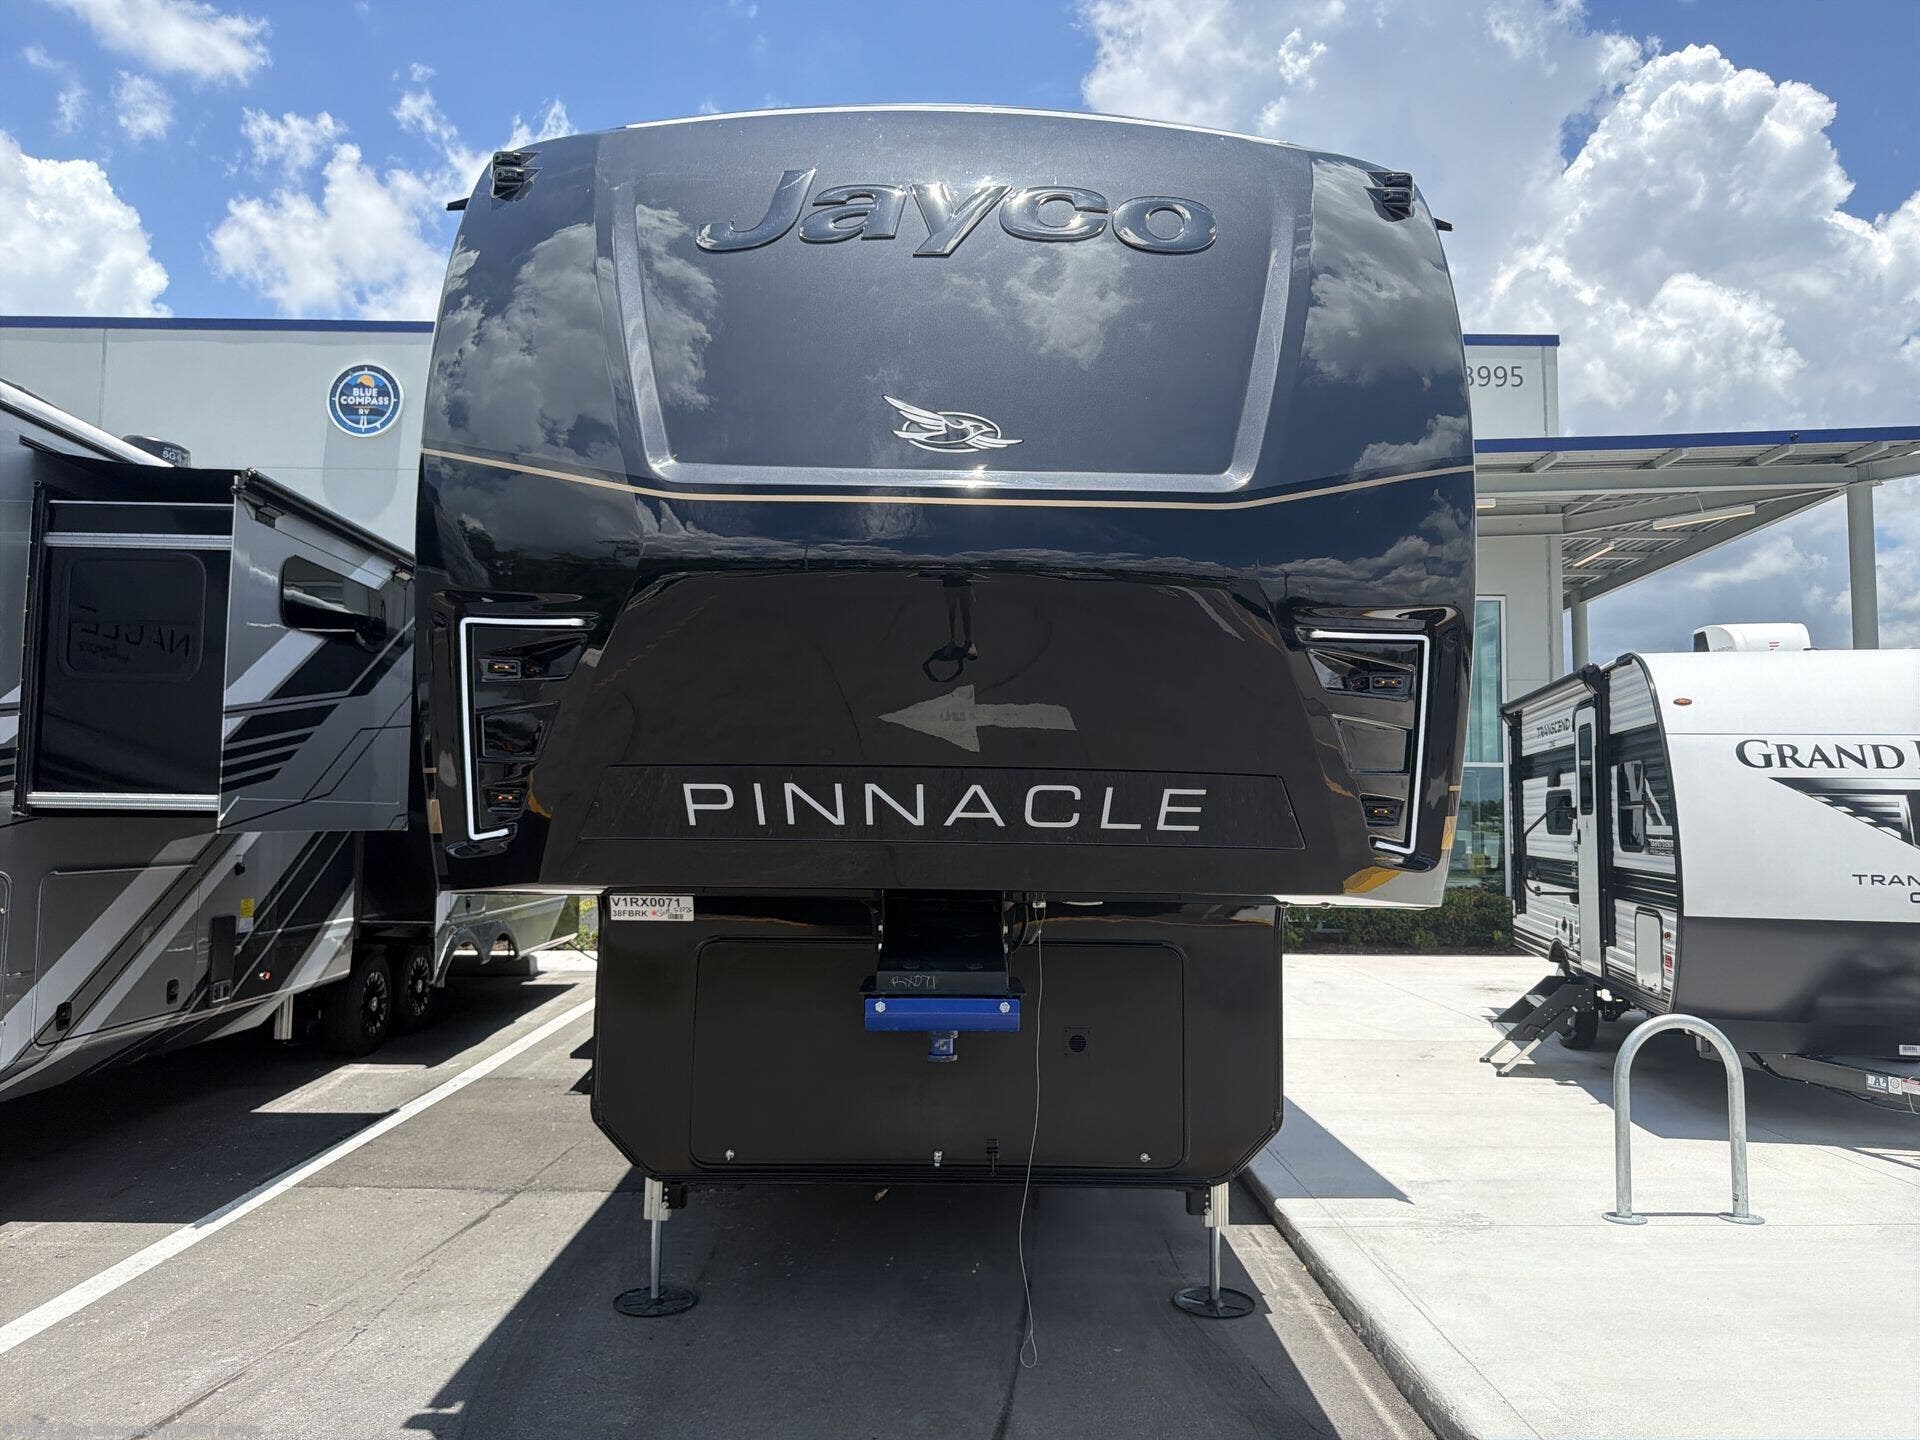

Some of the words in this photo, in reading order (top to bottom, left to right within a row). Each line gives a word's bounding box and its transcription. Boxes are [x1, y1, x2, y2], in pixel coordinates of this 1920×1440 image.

[696, 168, 1217, 257] Jayco
[352, 387, 378, 397] BLUE
[340, 395, 390, 405] COMPASS
[1735, 739, 1906, 770] GRAND
[682, 782, 1207, 832] PINNACLE
[611, 897, 681, 908] V1RX0071
[612, 909, 648, 918] 38FBRK
